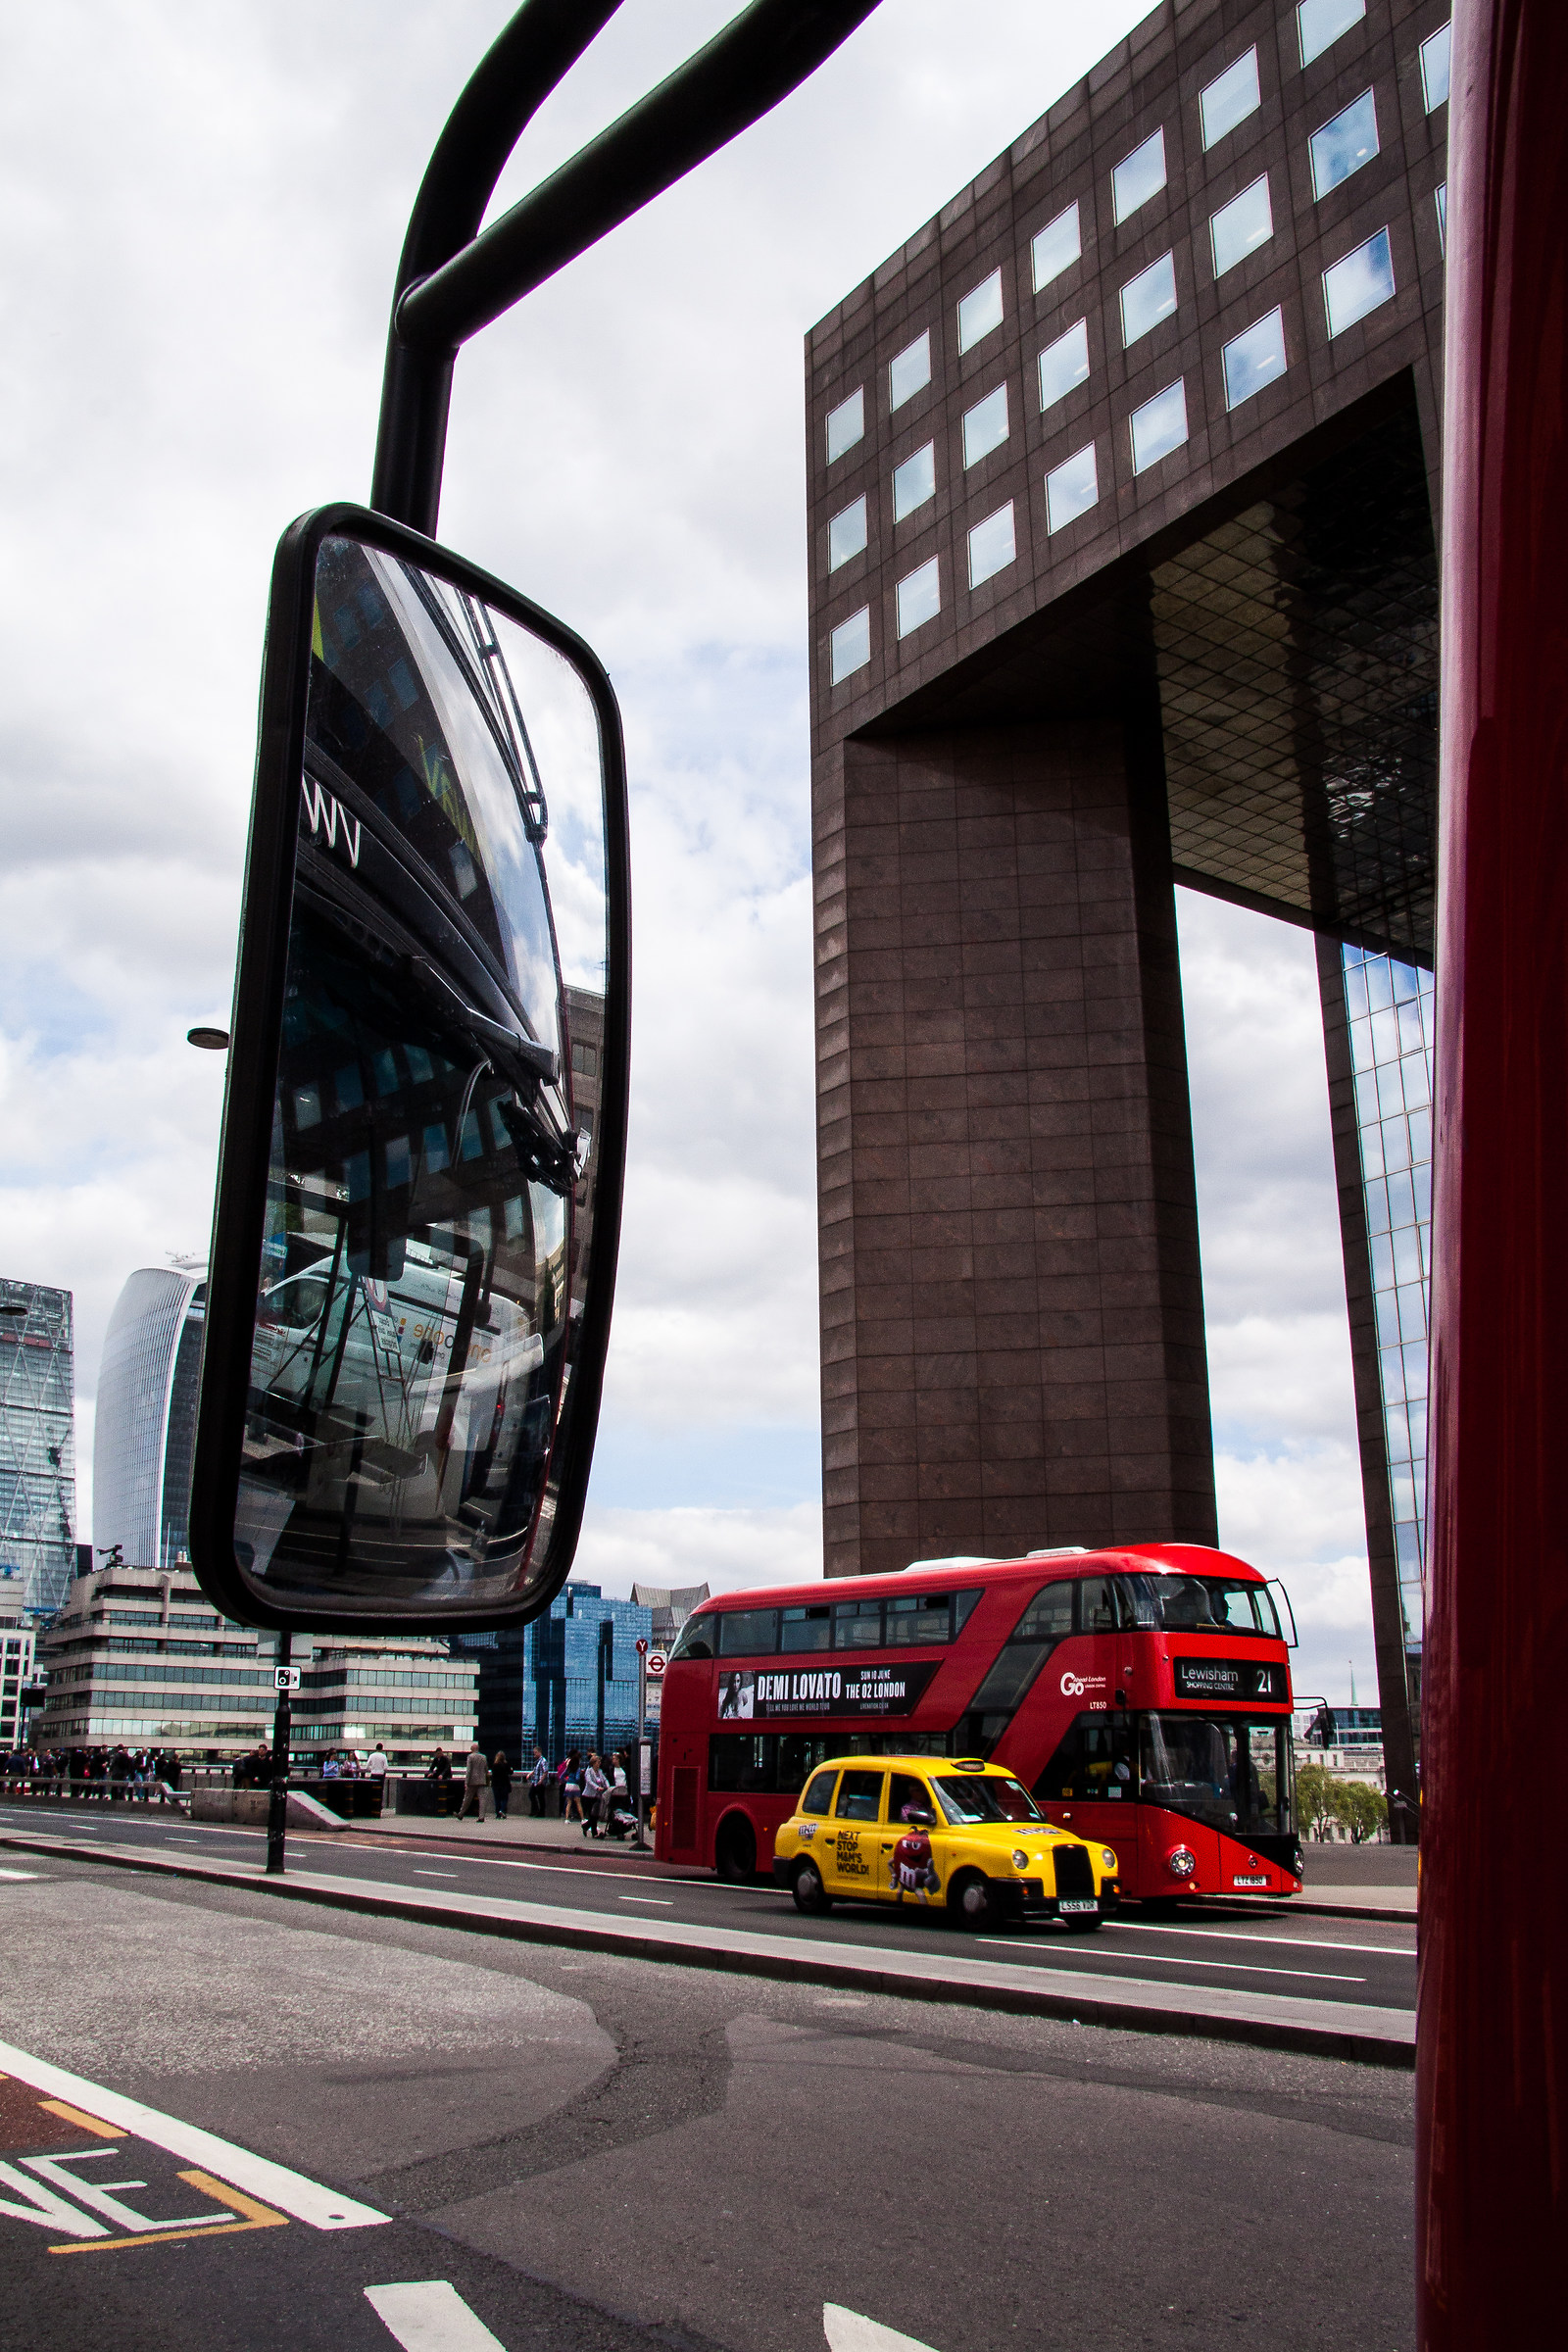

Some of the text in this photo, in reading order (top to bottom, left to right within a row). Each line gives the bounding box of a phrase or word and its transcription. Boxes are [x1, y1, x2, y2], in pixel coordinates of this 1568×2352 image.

[639, 1641, 646, 1651] Y
[860, 1670, 871, 1680] SUN
[878, 1669, 890, 1680] JUNE
[1181, 1665, 1239, 1682] Lewisham
[757, 1672, 841, 1700] DEMI LOVATO
[1060, 1672, 1084, 1696] Go
[1186, 1681, 1213, 1690] SHOPPING
[1256, 1669, 1272, 1692] 21
[846, 1684, 859, 1698] THE
[873, 1682, 906, 1698] LONDON
[838, 1831, 860, 1840] NEXT
[837, 1840, 858, 1851] STOP
[837, 1851, 862, 1863] M&M'S
[837, 1862, 869, 1875] WORLD!
